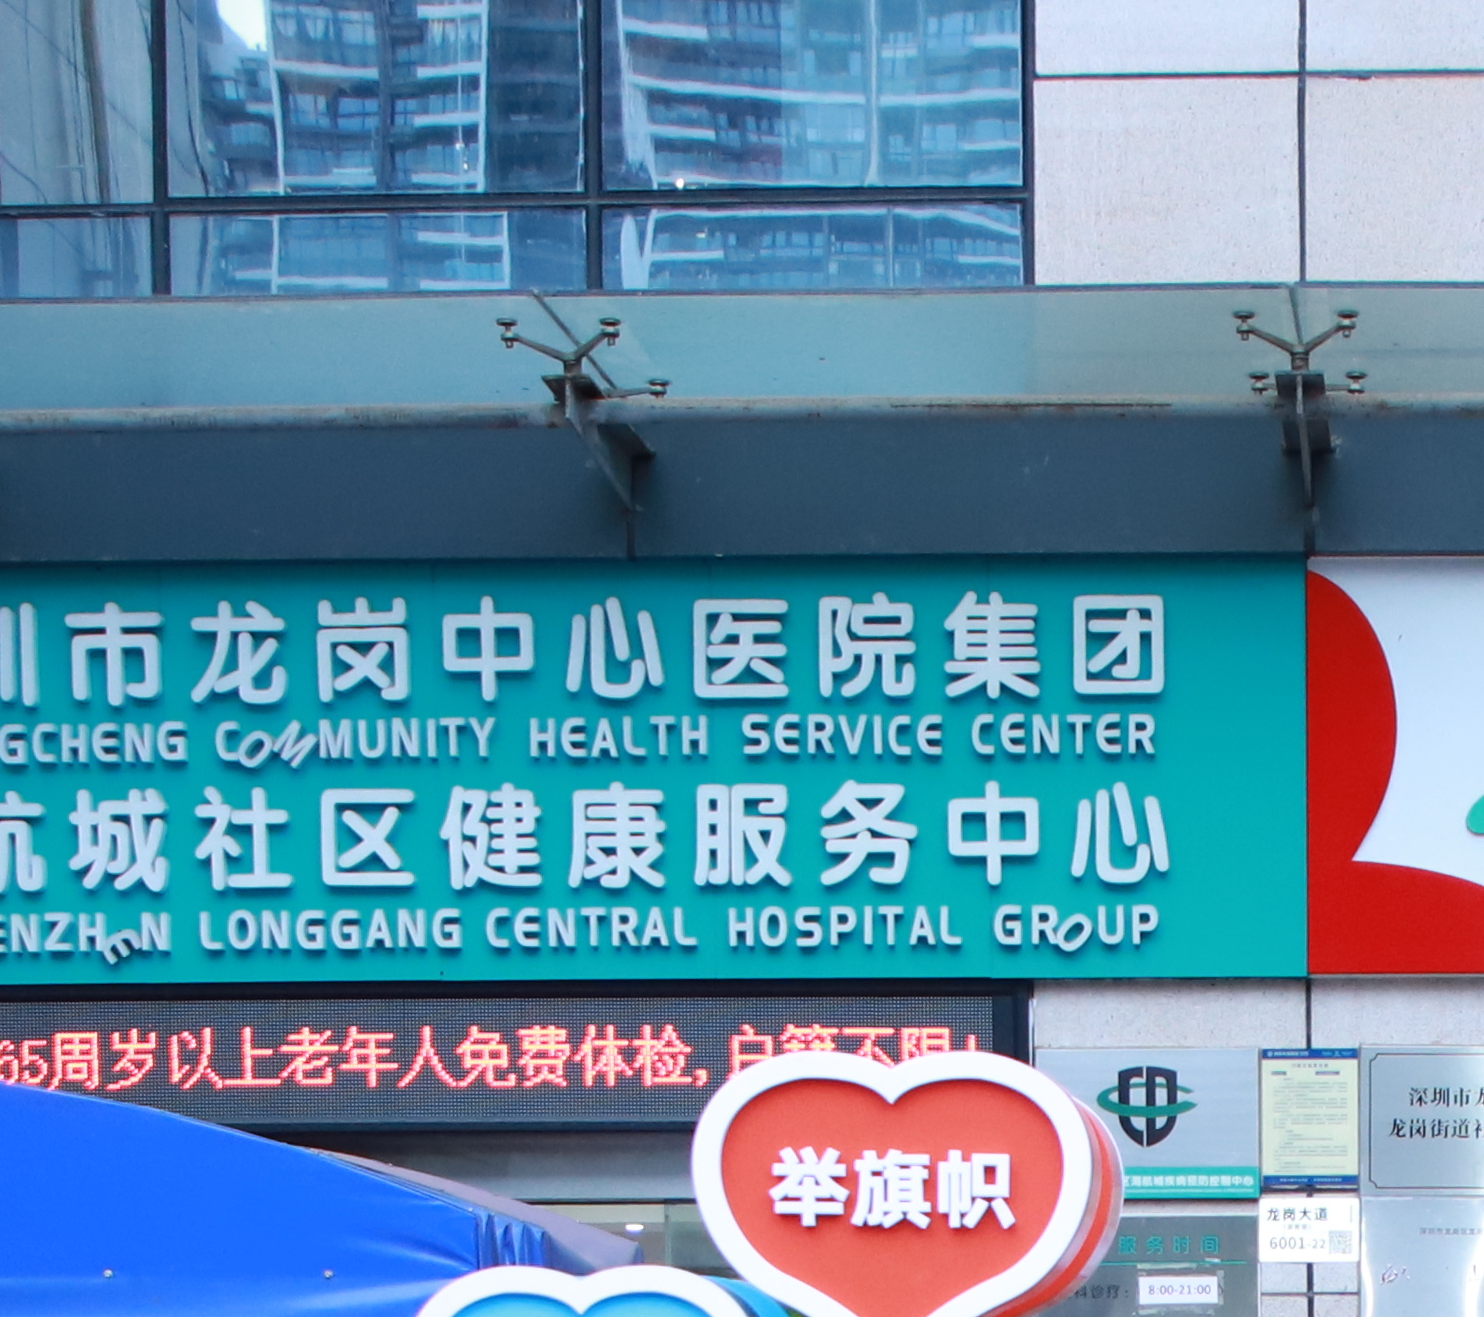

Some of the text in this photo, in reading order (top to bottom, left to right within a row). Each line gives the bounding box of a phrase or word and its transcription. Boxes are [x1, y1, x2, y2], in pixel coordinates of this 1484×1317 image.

[530, 714, 709, 758] HEALTH
[742, 713, 944, 757] SERVICE
[971, 712, 1157, 755] CENTER
[199, 907, 462, 952] LONGGANG
[486, 907, 697, 949] CENTRAL
[728, 905, 962, 948] HOSPITAL
[993, 903, 1161, 953] GROUP
[768, 1146, 1017, 1230] 举旗帜
[1266, 1207, 1328, 1222] 龙岗大道
[1118, 1235, 1220, 1255] 服务时间
[1269, 1236, 1326, 1250] 6001-22
[1069, 1284, 1212, 1300] 科诊疗： 8:00-21:00
